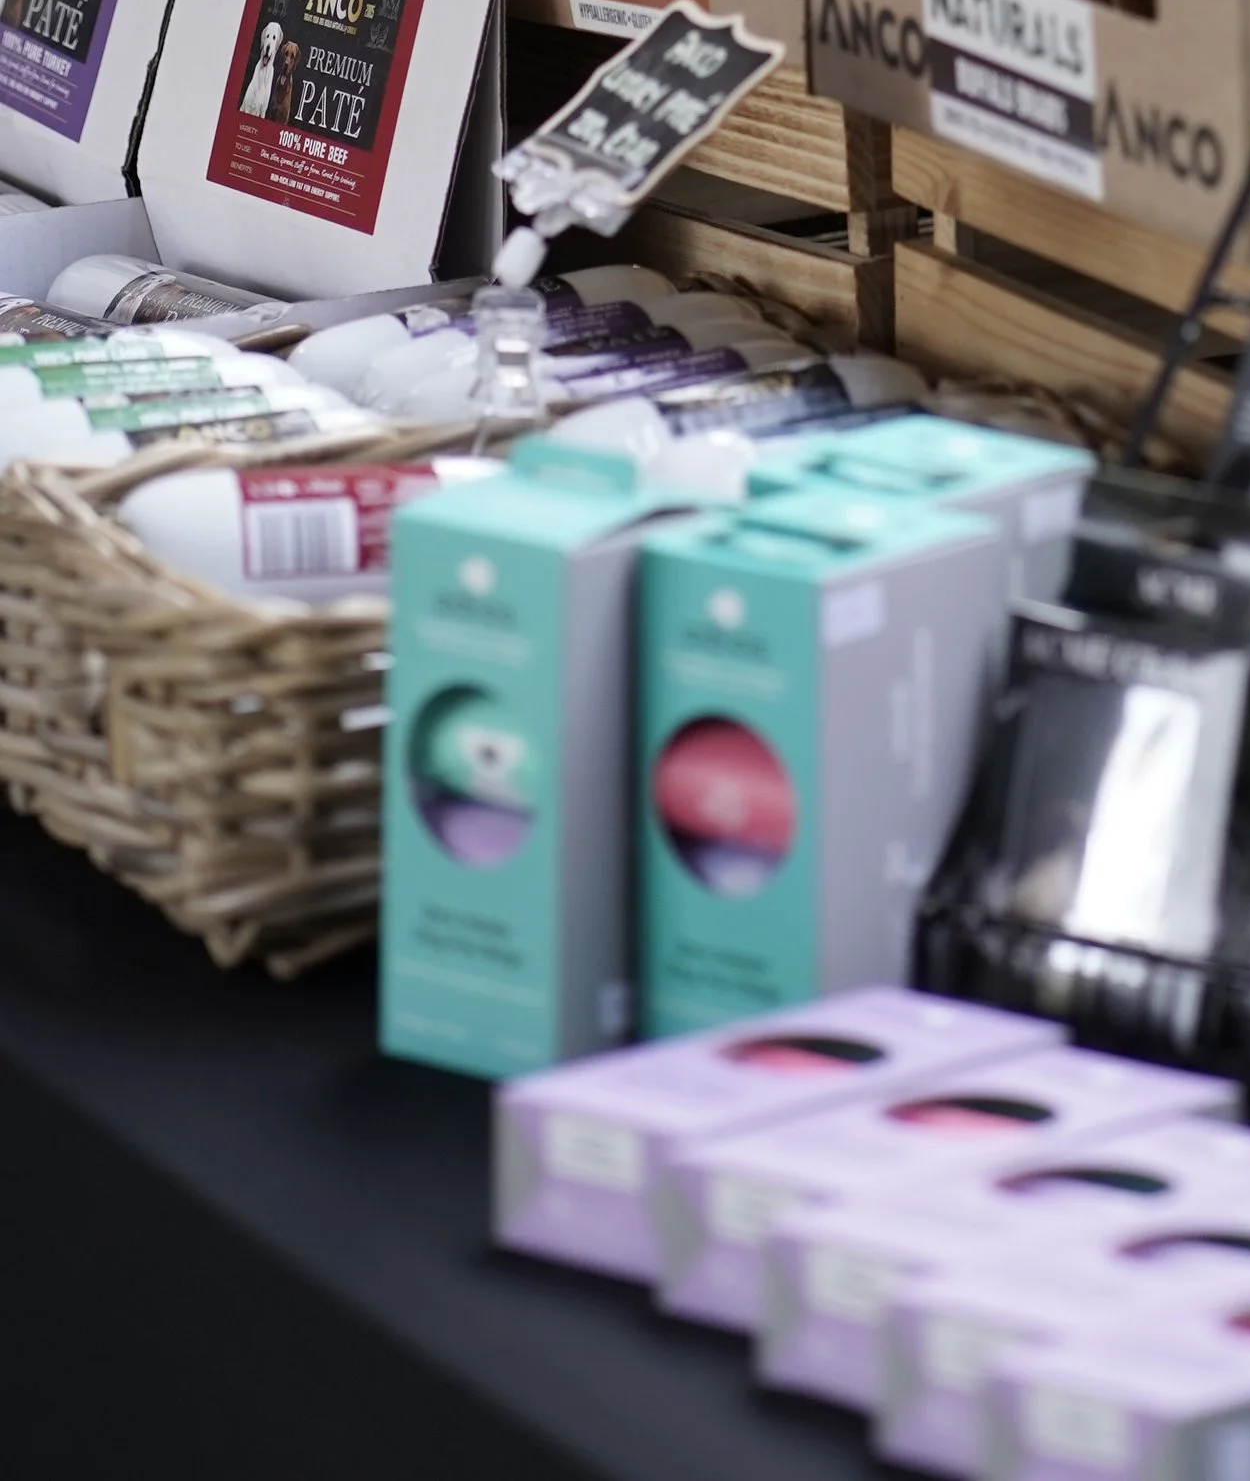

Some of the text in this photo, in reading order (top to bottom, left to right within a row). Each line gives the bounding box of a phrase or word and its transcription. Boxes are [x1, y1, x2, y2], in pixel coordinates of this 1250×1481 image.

[306, 45, 375, 87] PREMIUM
[294, 79, 367, 139] PATÉ
[1102, 76, 1225, 188] ANCO
[278, 129, 349, 166] 100% PURE BEEF
